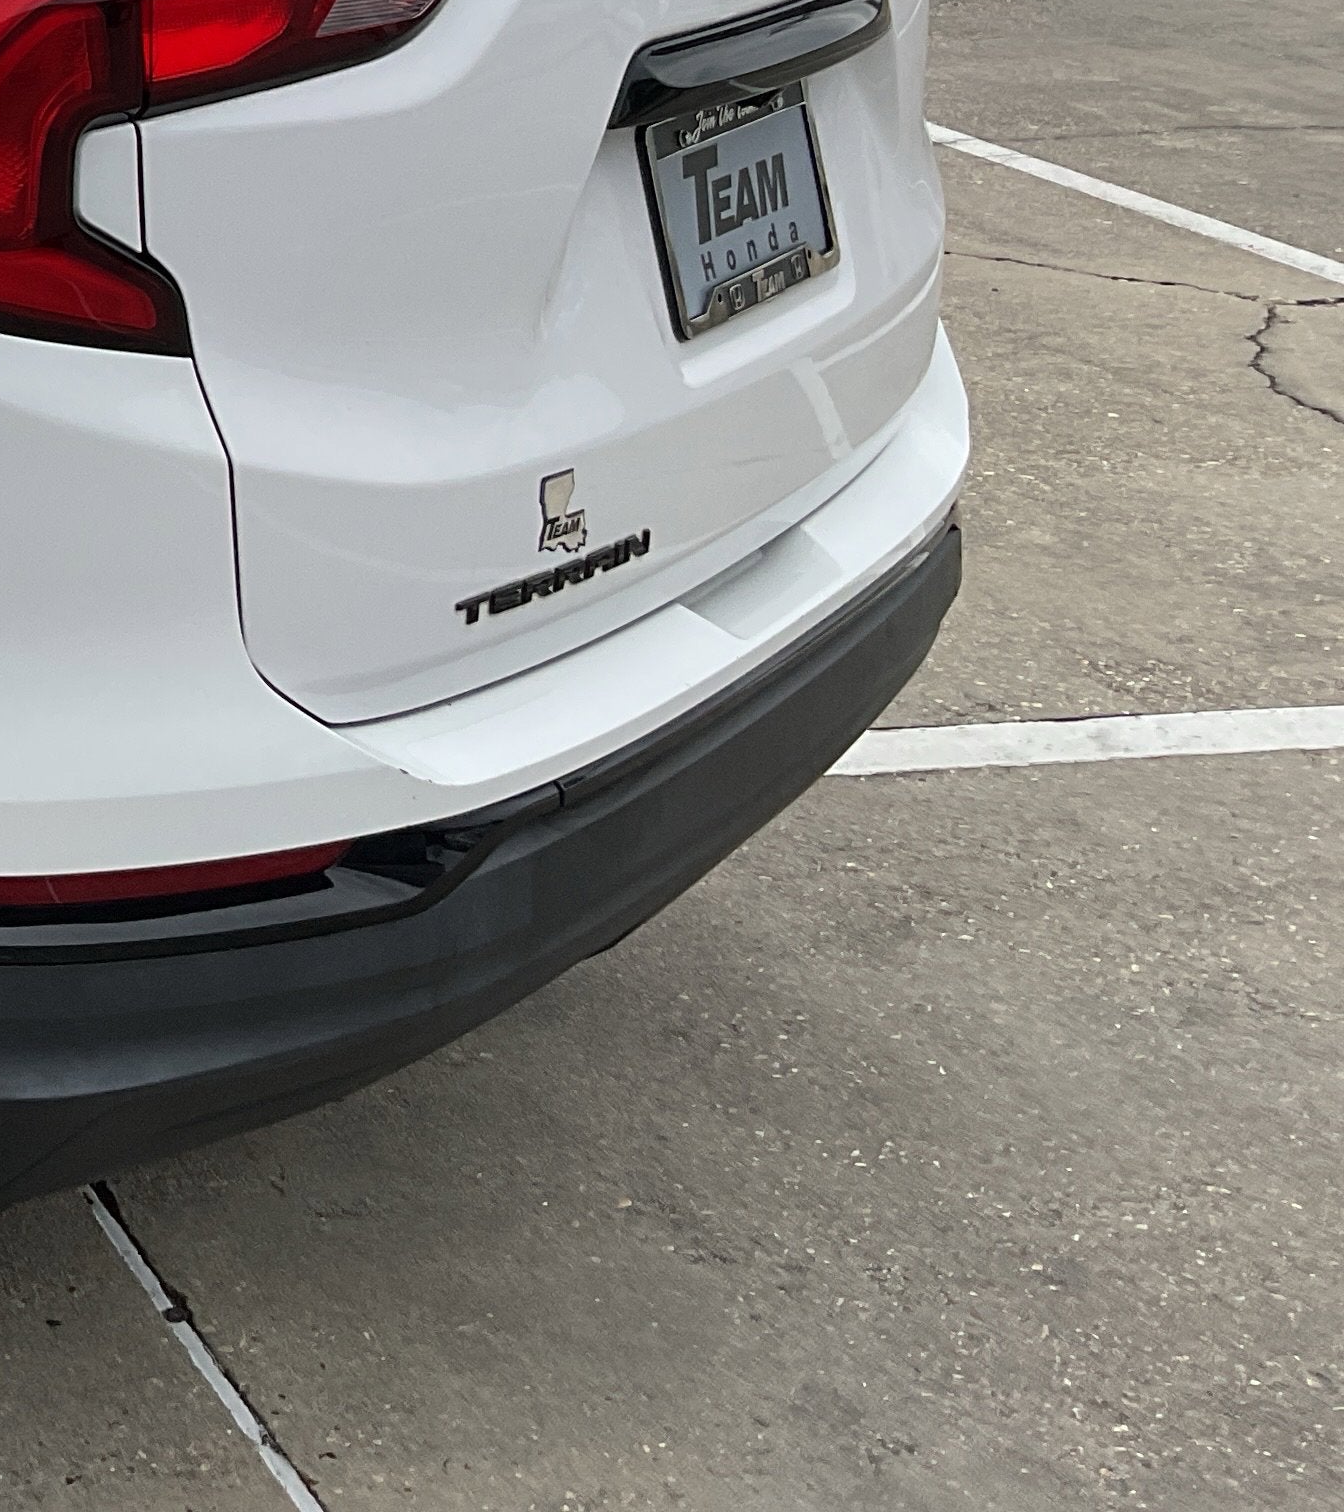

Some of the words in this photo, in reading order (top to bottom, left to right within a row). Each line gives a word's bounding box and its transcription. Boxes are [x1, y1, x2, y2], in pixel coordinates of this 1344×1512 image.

[682, 142, 790, 246] TEAM
[700, 220, 800, 283] Honda
[752, 268, 787, 304] TEAM
[546, 514, 581, 541] TEAM
[454, 527, 651, 626] TERRAIN
